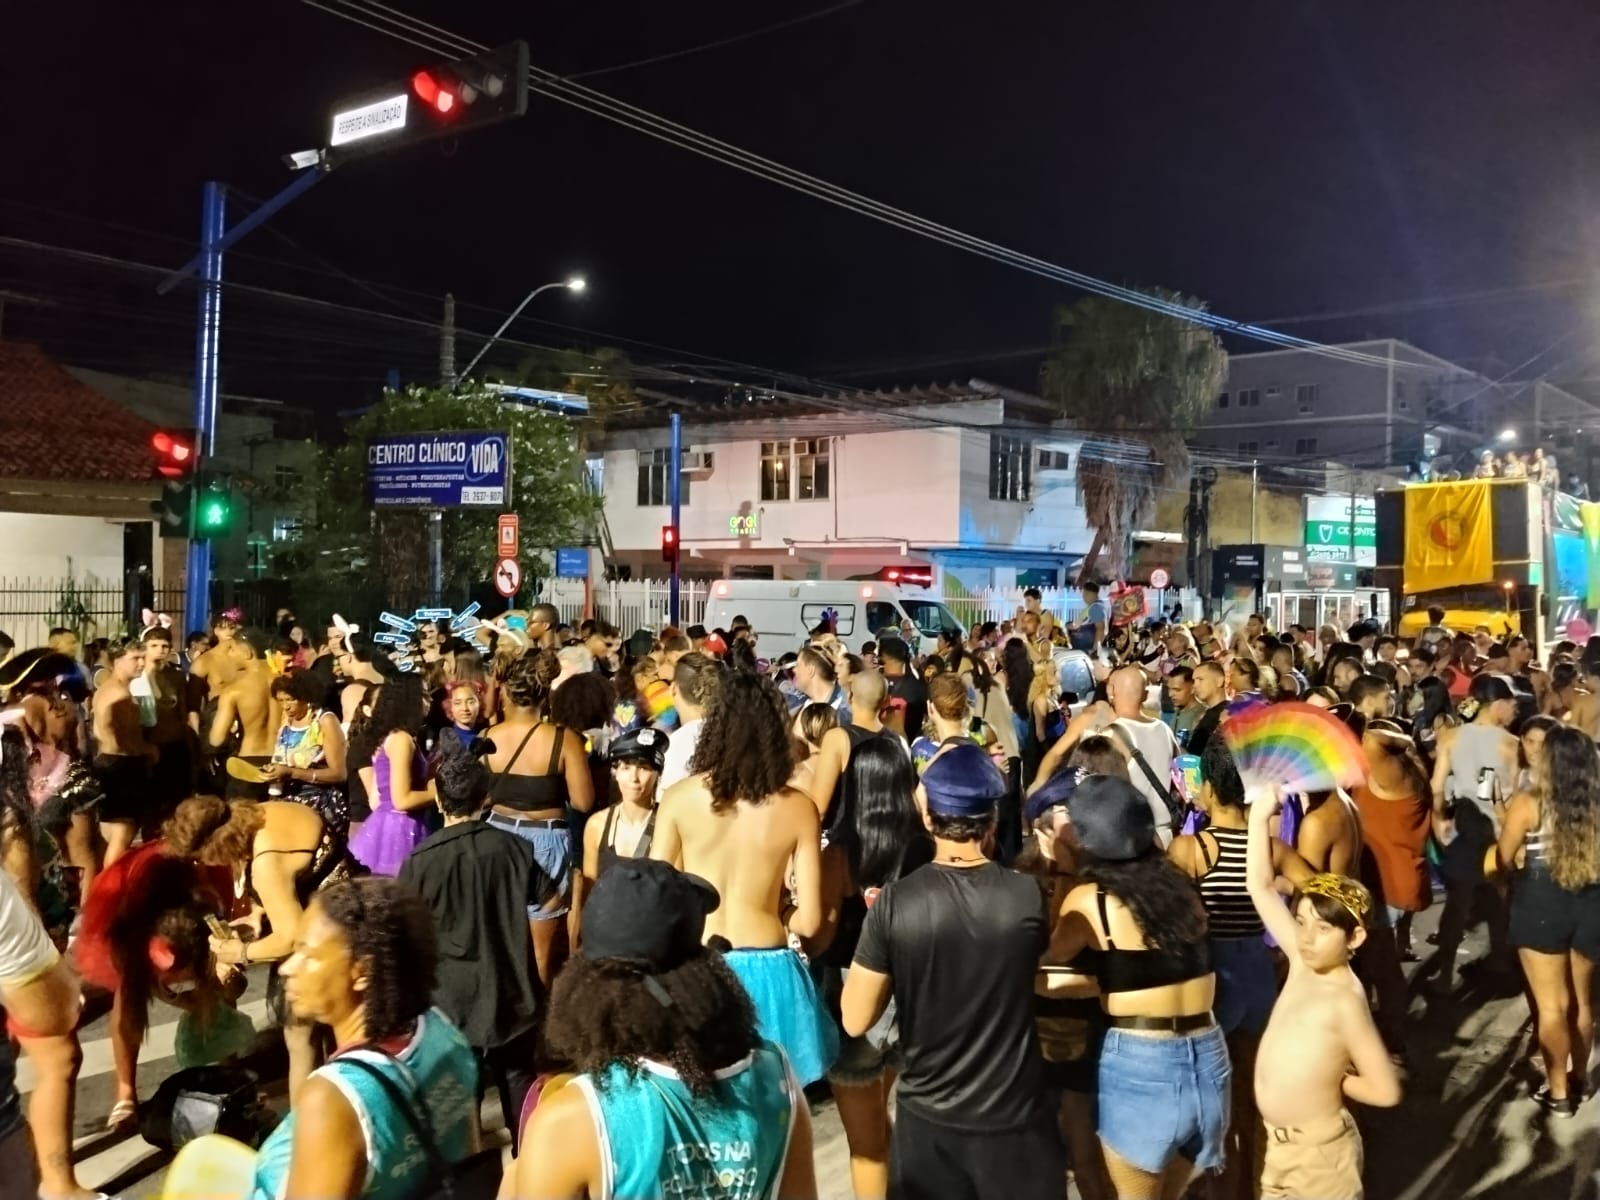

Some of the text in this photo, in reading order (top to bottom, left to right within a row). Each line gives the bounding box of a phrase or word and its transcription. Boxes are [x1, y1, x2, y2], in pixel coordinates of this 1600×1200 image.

[368, 437, 466, 465] CENTRO CLÍNICO
[471, 443, 499, 474] VIDA
[724, 1140, 752, 1162] NA
